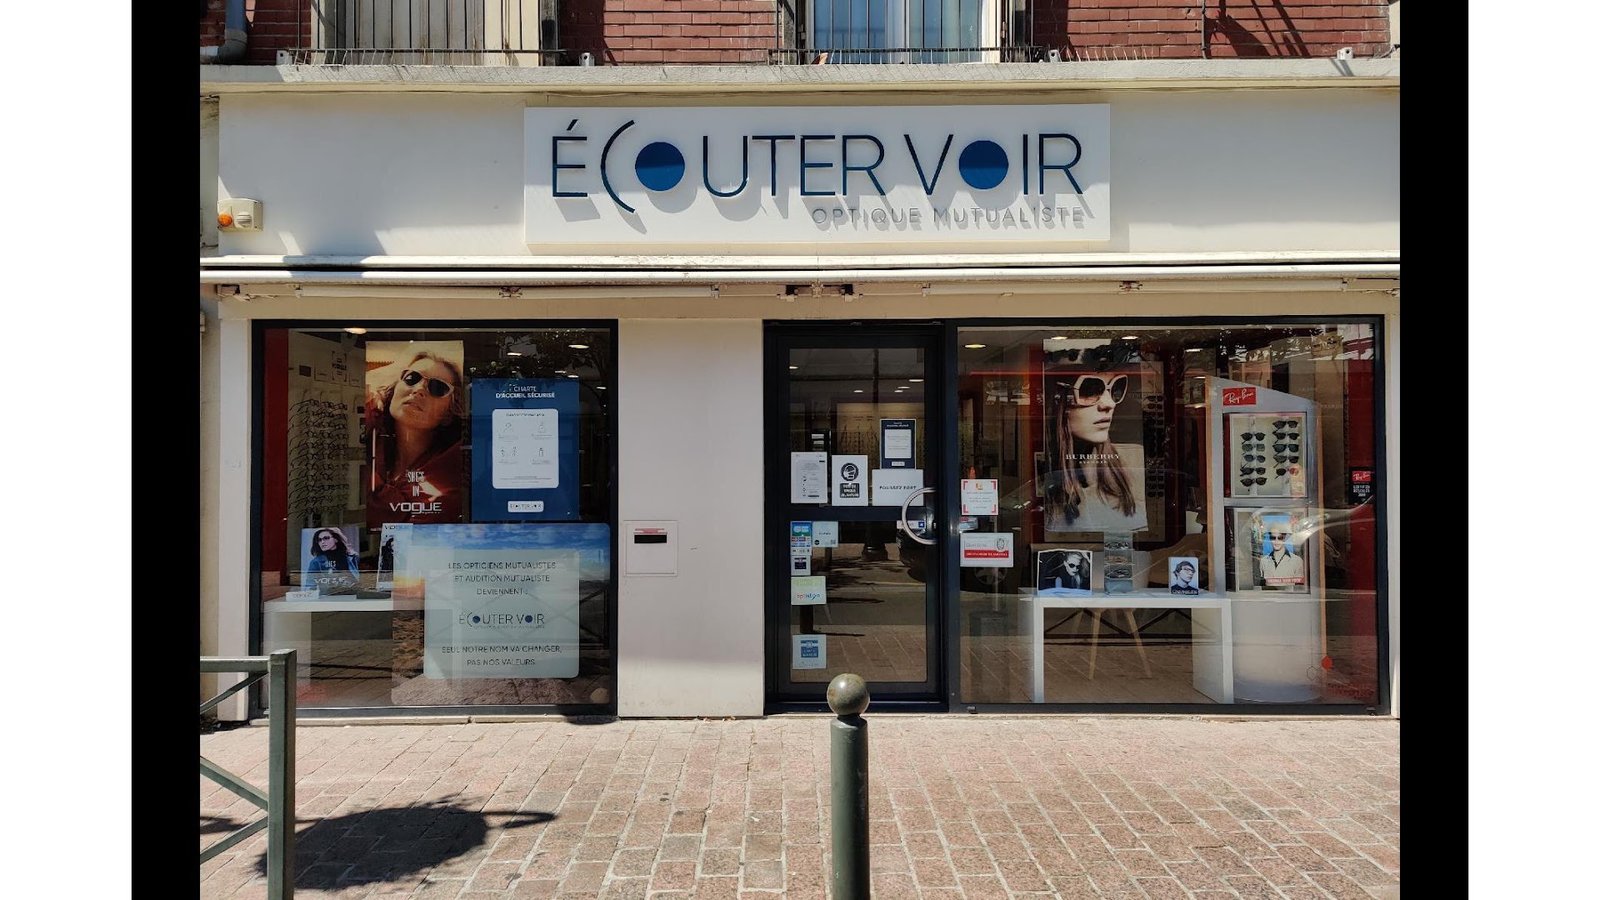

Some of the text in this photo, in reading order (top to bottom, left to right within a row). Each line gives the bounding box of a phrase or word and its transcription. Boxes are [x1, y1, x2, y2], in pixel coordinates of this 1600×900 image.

[551, 119, 1084, 213] ÉCOUTER VOIR
[812, 206, 1084, 225] OPTIQUE MUTUALISTE
[412, 485, 420, 497] IN
[389, 502, 442, 515] VOGUE
[448, 561, 556, 570] LES OPTICIENS MUTUALISTES
[516, 613, 545, 625] VOIR
